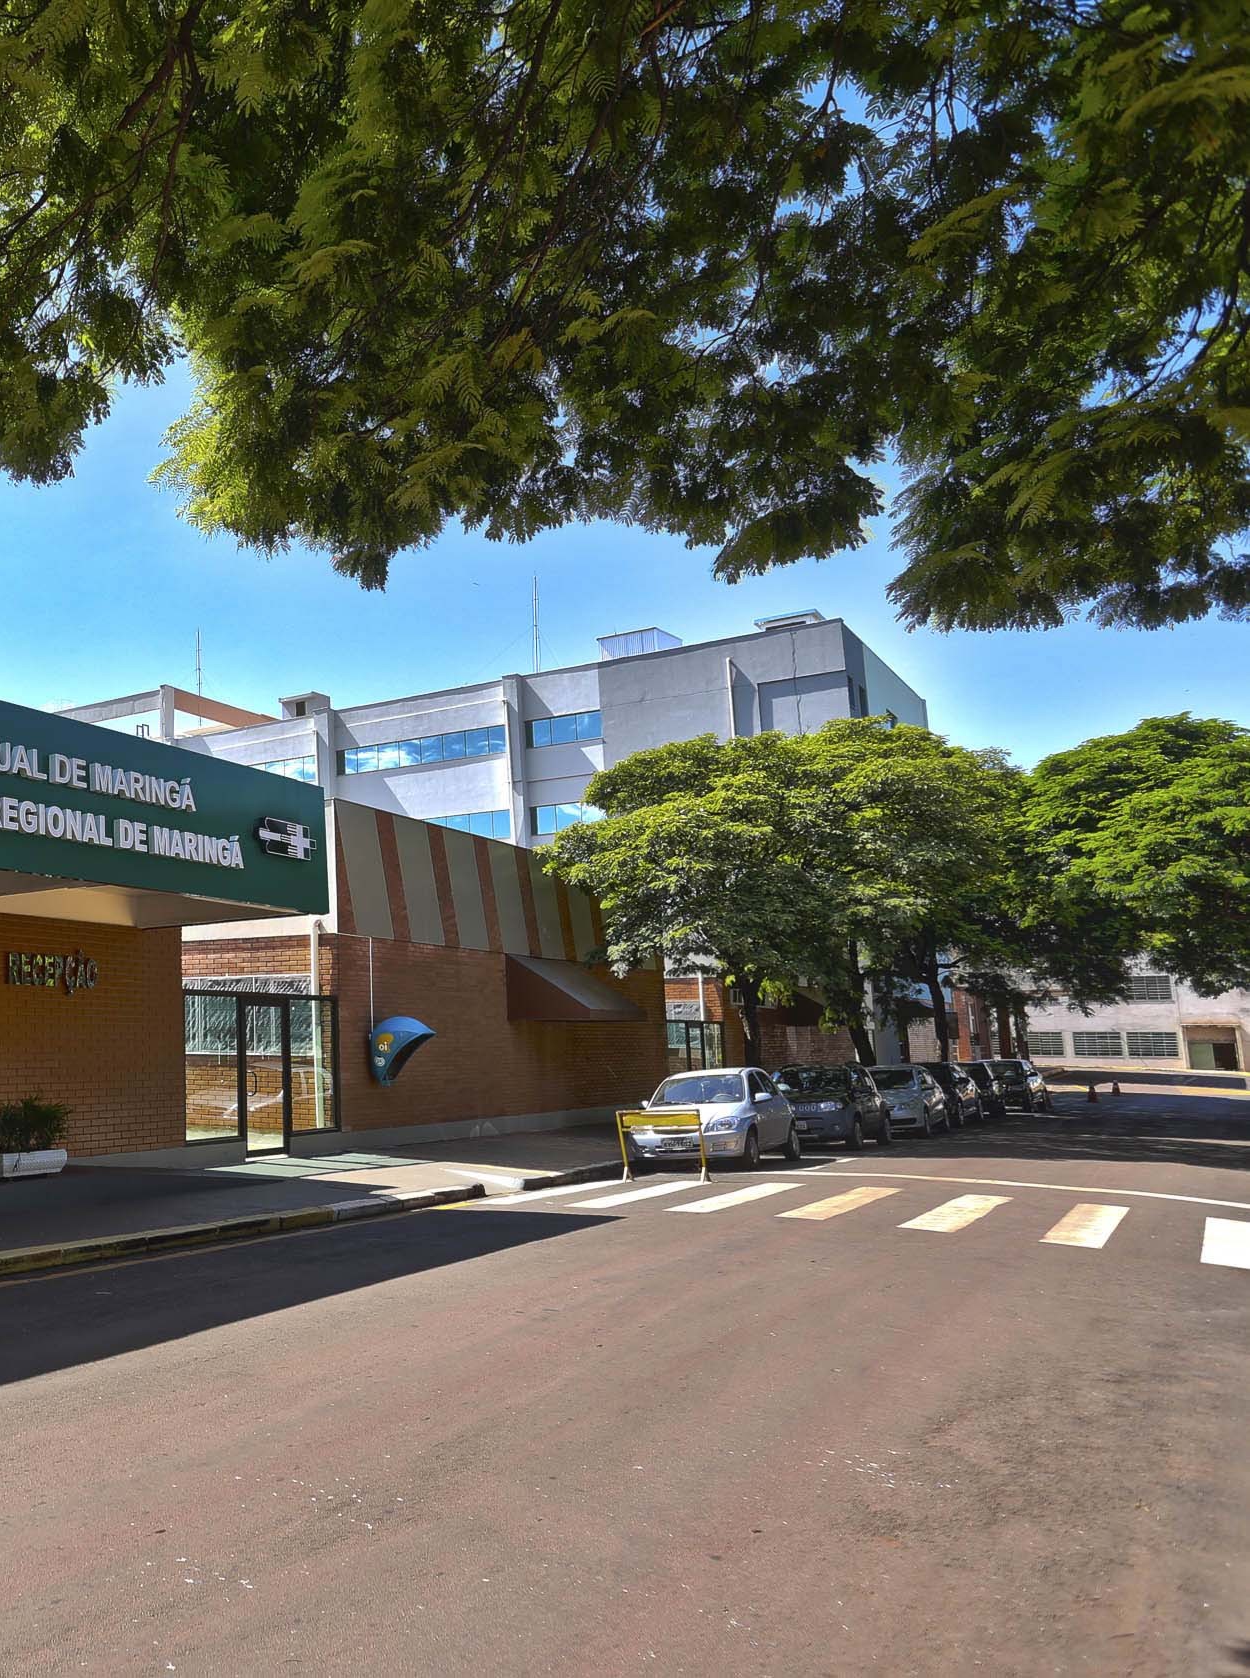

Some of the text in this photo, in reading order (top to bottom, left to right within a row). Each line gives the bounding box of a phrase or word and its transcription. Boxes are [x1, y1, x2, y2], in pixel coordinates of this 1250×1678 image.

[50, 753, 88, 789] DE
[90, 762, 197, 812] MARINGÁ
[114, 818, 148, 853] DE
[149, 825, 245, 870] MARINGÁ
[8, 949, 98, 995] RECEPÇÃO
